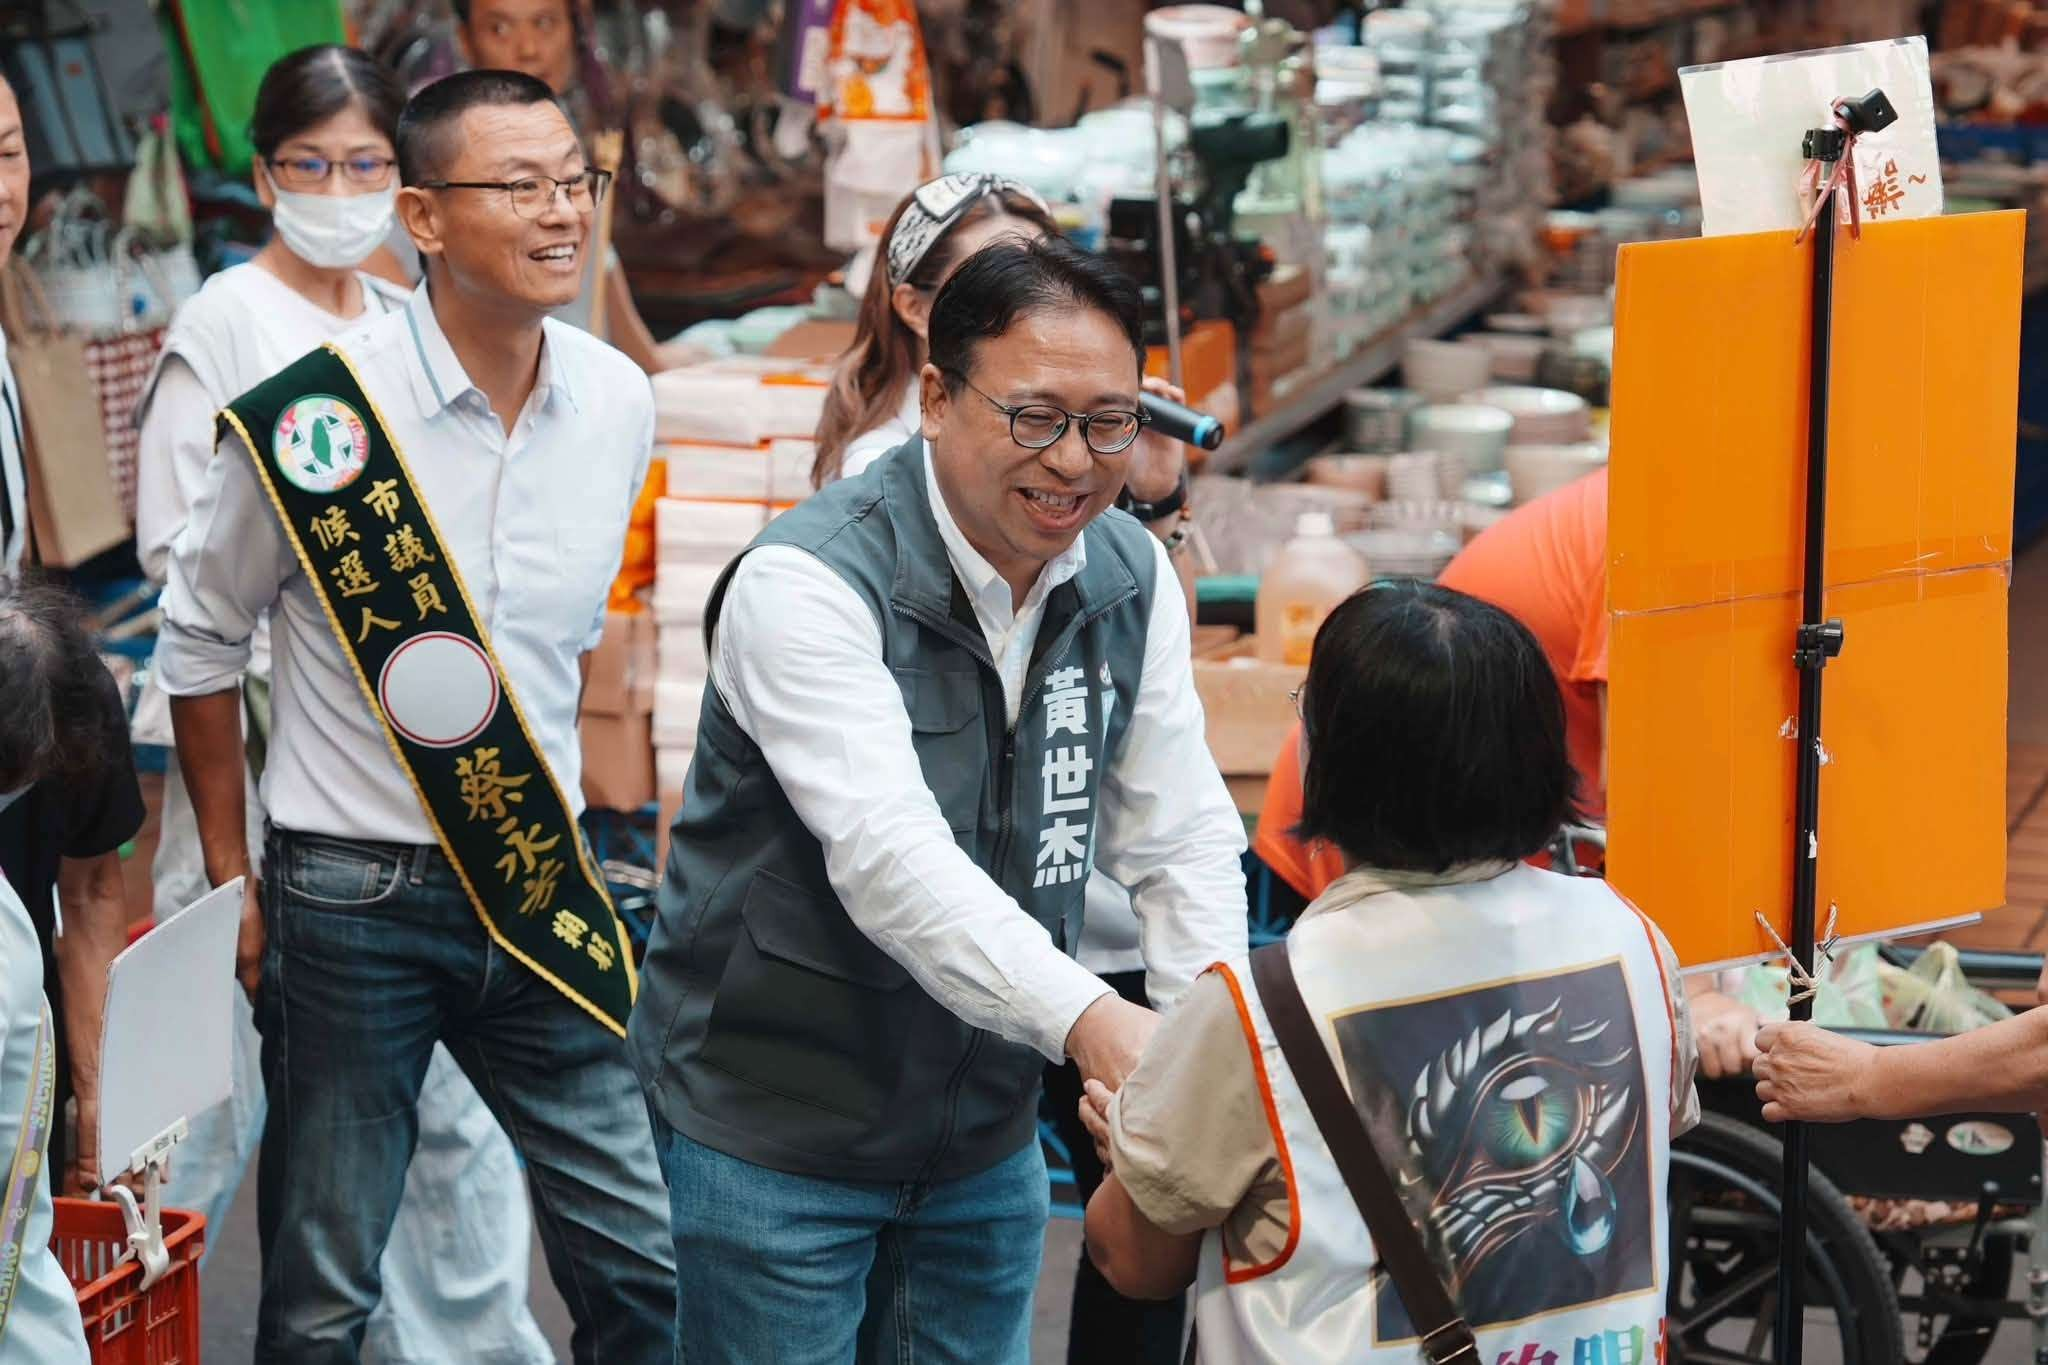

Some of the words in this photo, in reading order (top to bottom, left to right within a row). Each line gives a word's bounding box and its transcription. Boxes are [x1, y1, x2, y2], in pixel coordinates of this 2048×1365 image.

[309, 505, 402, 643] 候選人
[361, 478, 448, 621] 市議員
[1033, 665, 1093, 888] 黃世杰
